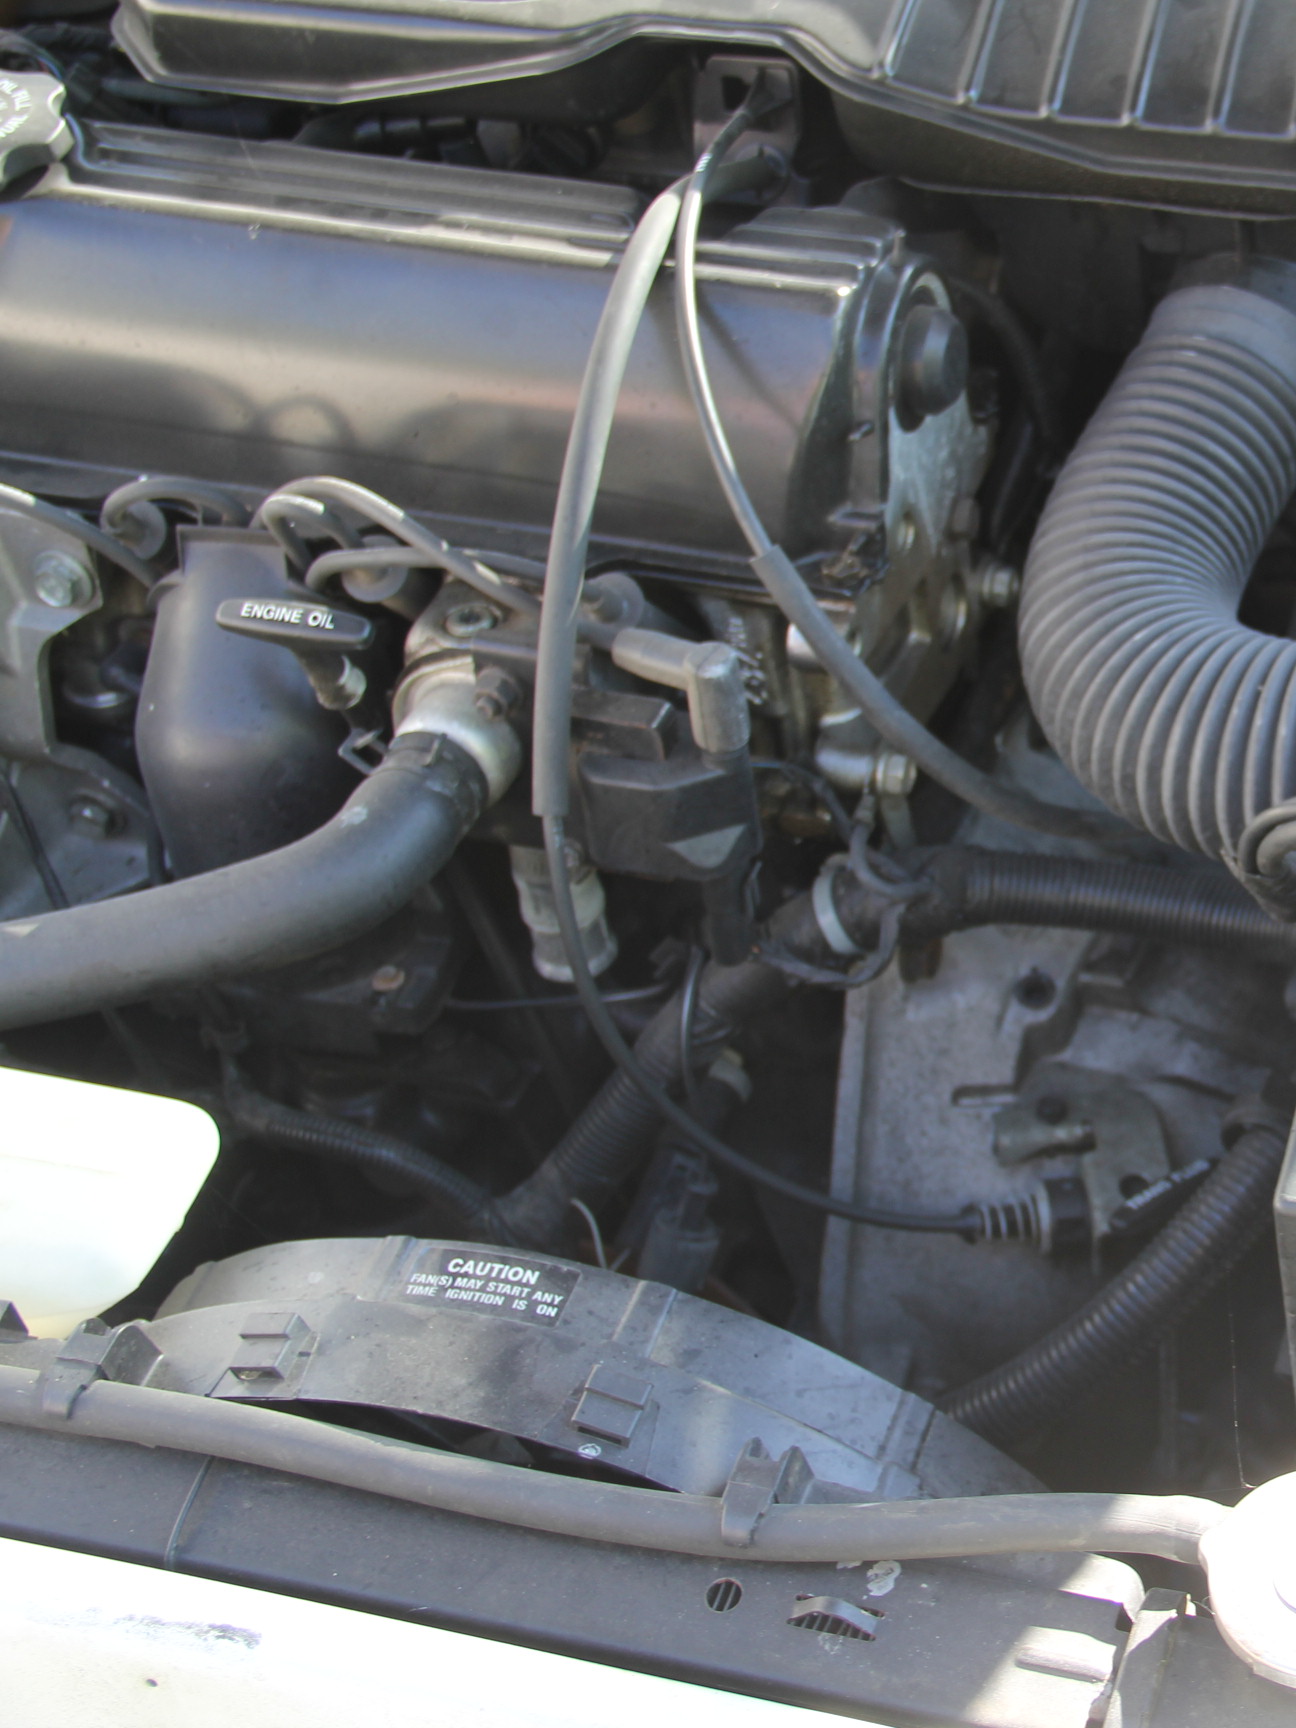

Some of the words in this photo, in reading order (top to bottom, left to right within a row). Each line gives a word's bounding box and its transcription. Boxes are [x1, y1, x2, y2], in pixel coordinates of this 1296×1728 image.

[240, 602, 304, 624] ENGINE
[307, 610, 335, 630] OIL
[448, 1258, 540, 1285] CAUTION
[405, 1285, 438, 1297] TIME
[445, 1287, 505, 1306] IGNITION
[512, 1298, 529, 1311] IS
[536, 1304, 559, 1317] ON
[410, 1273, 453, 1289] FAN(S)
[453, 1276, 486, 1290] MAY
[486, 1281, 532, 1298] START
[532, 1291, 565, 1305] ANY
